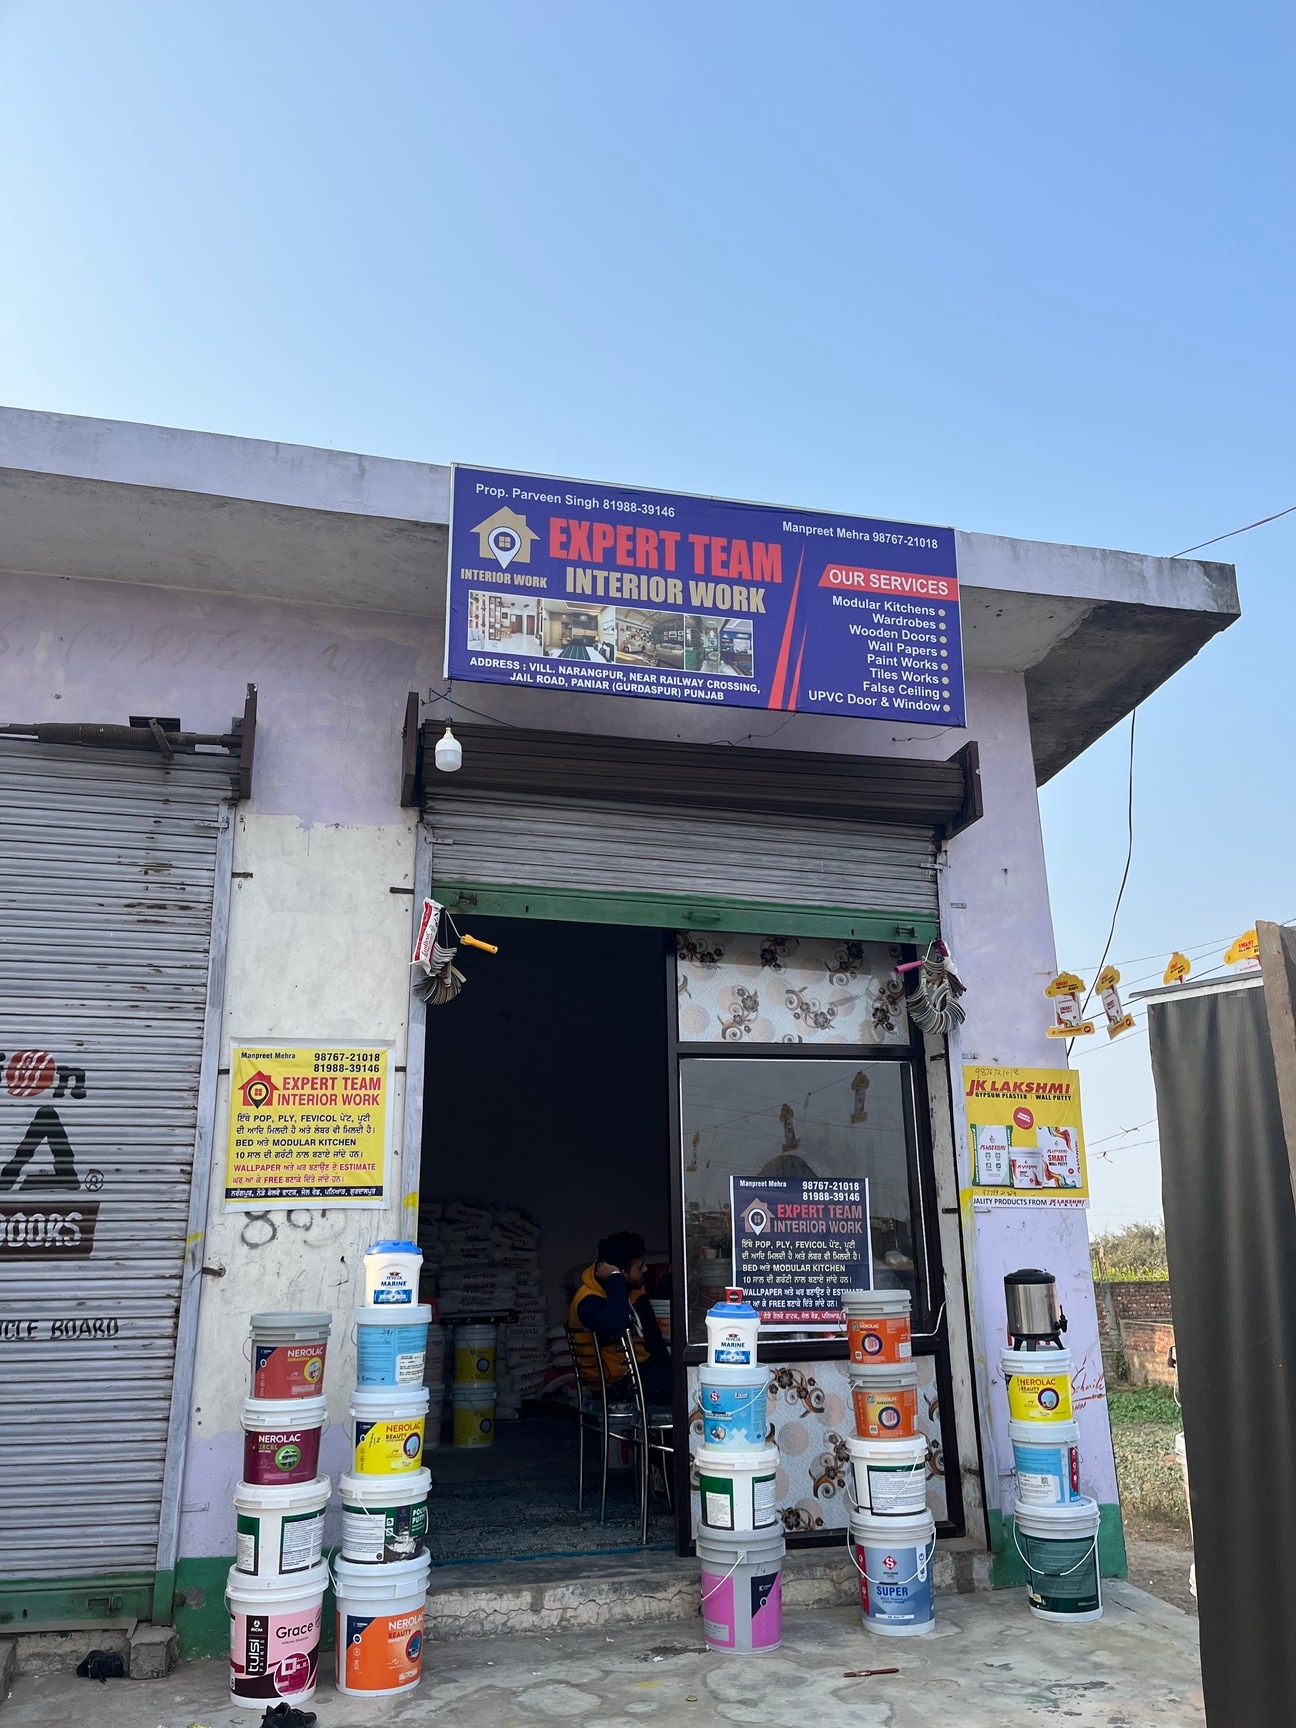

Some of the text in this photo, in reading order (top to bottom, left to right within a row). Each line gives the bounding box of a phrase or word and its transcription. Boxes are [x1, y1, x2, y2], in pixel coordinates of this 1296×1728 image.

[476, 483, 675, 517] Prop. Parveen Singh 81988-39146
[782, 521, 938, 549] Manpreet Mehra 98767-21018
[550, 517, 782, 583] EXPERT TEAM
[461, 568, 547, 588] INTERIOR WORK
[829, 569, 948, 595] OUR SERVICES
[566, 567, 766, 613] INTERIOR WORK
[832, 596, 936, 616] Modular Kitchens
[872, 614, 936, 629] Wardrobes
[849, 625, 937, 642] Wooden Doors
[868, 640, 937, 656] Wall Papers
[867, 654, 938, 670] Paint Works
[470, 657, 520, 670] ADDRESS
[529, 663, 555, 673] VILL.
[558, 666, 626, 681] NARANGPUR,
[630, 672, 657, 683] NEAR
[660, 676, 704, 687] RAILWAY
[707, 680, 760, 694] CROSSING,
[870, 668, 939, 684] Tiles Works
[510, 673, 724, 700] JAIL ROAD, PANIAR (GURDASPUR) PUNJAB
[863, 681, 939, 700] False Ceiling
[808, 690, 941, 711] UPVC Door & Window
[241, 1052, 272, 1060] Manpreet
[314, 1053, 380, 1062] 98767-21018
[314, 1064, 380, 1072] 81988-39146
[282, 1077, 381, 1090] EXPERT TEAM
[966, 1080, 1071, 1096] JK LAKSHMI
[278, 1093, 380, 1106] INTERIOR WORK
[802, 1181, 859, 1190] 98767-21018
[803, 1192, 860, 1201] 81988-39146
[777, 1204, 862, 1218] EXPERT TEAM
[774, 1221, 862, 1233] INTERIOR WORK
[755, 1241, 773, 1249] POP,
[776, 1241, 792, 1249] PLY,
[50, 1318, 120, 1340] BOARD
[288, 1347, 324, 1357] NEROLAC
[386, 1422, 421, 1432] NEROLAC
[259, 1434, 301, 1443] NEROLAC
[877, 1586, 908, 1596] SUPER
[276, 1622, 313, 1638] Grace
[388, 1629, 412, 1639] BEAUTY
[248, 1639, 260, 1672] tulsi
